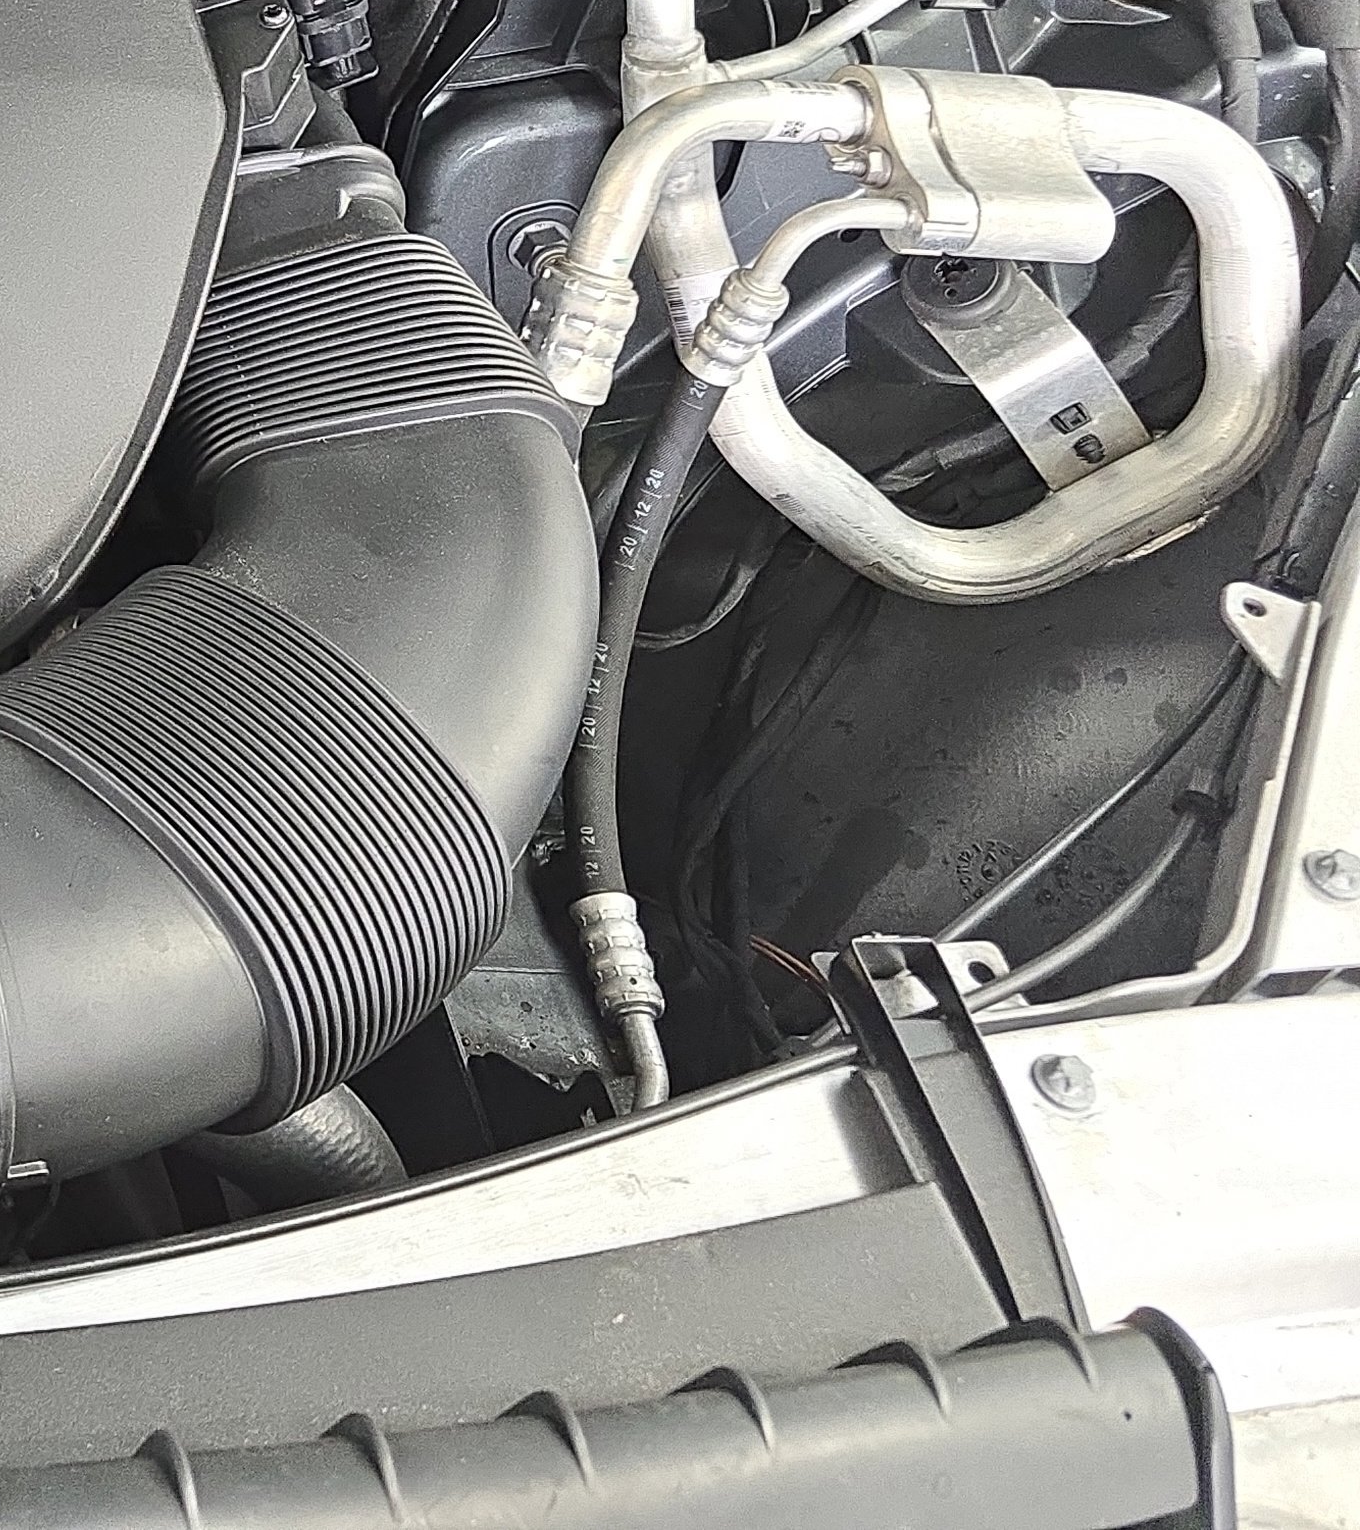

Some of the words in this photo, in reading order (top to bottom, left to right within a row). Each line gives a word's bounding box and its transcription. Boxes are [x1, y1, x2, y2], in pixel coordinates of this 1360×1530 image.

[689, 379, 708, 399] 20
[619, 536, 638, 557] 20
[634, 501, 652, 521] 12
[644, 468, 665, 489] 20
[587, 678, 601, 695] 12
[581, 716, 597, 737] 20
[580, 825, 596, 846] 20
[585, 860, 599, 879] 12
